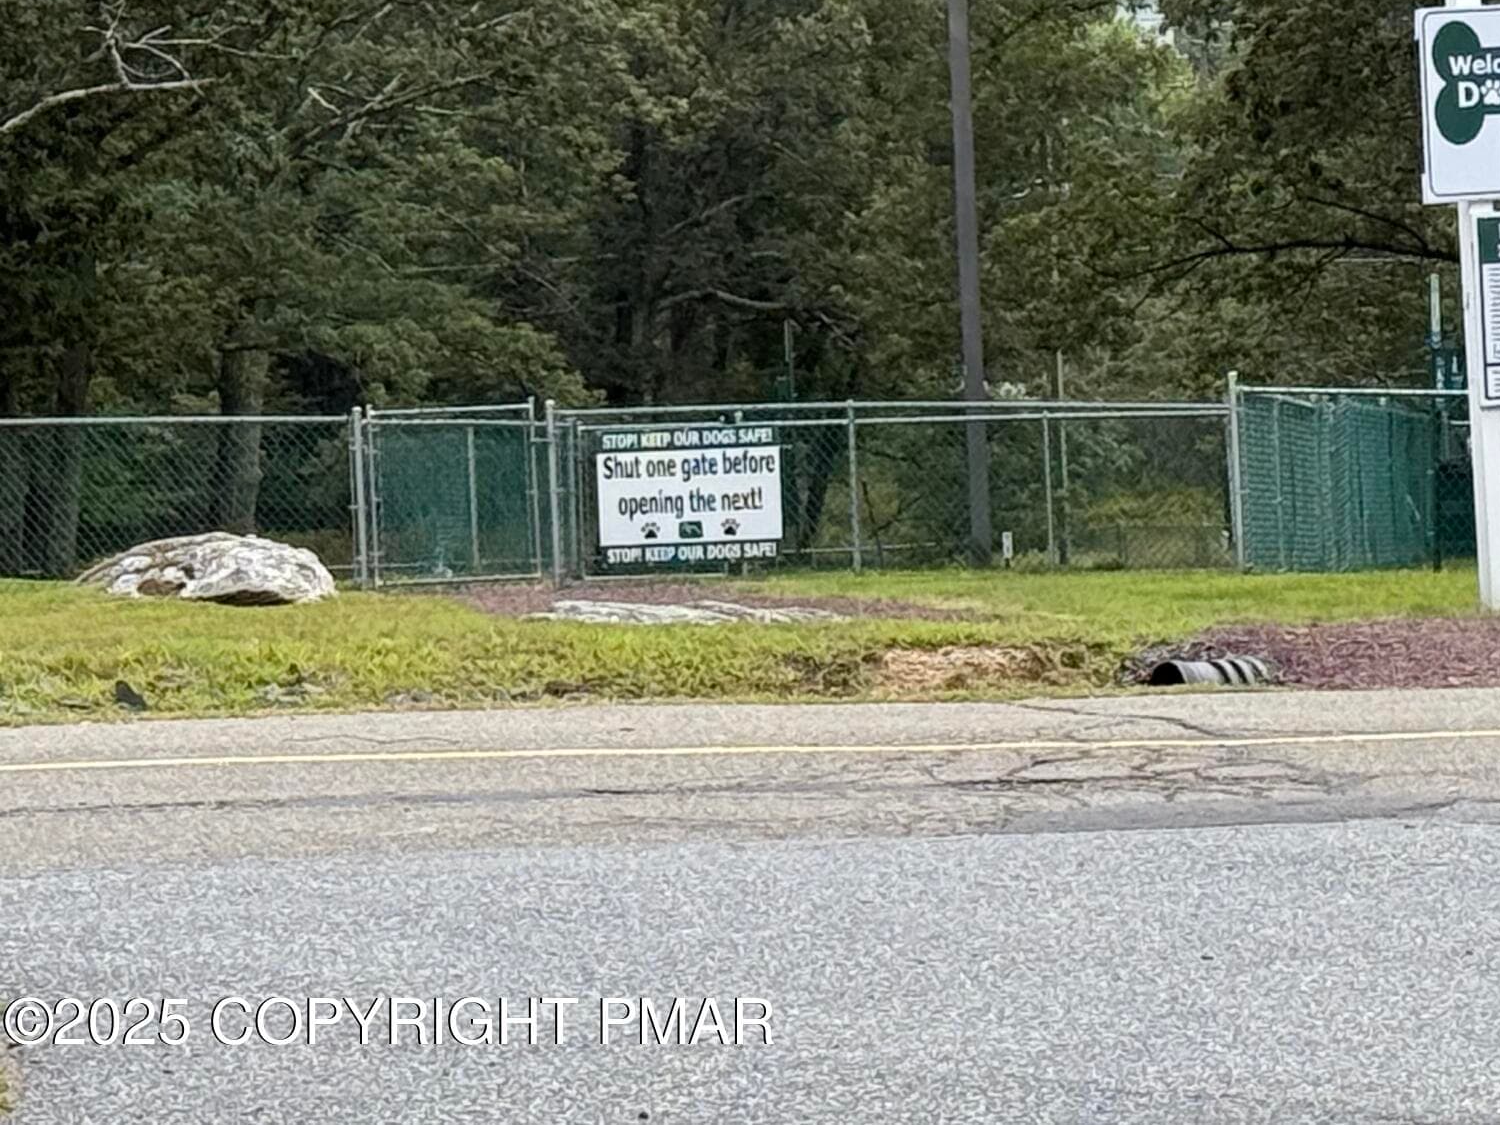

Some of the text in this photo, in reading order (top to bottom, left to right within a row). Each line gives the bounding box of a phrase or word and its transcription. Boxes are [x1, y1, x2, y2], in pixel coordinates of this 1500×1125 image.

[602, 428, 772, 450] STOP! KEEP OUR DOGS SAFE!
[603, 450, 775, 482] Shut one gate before
[618, 486, 763, 520] opening the next!
[607, 542, 777, 564] STOP! KEEP OUR DOGS SAFE!
